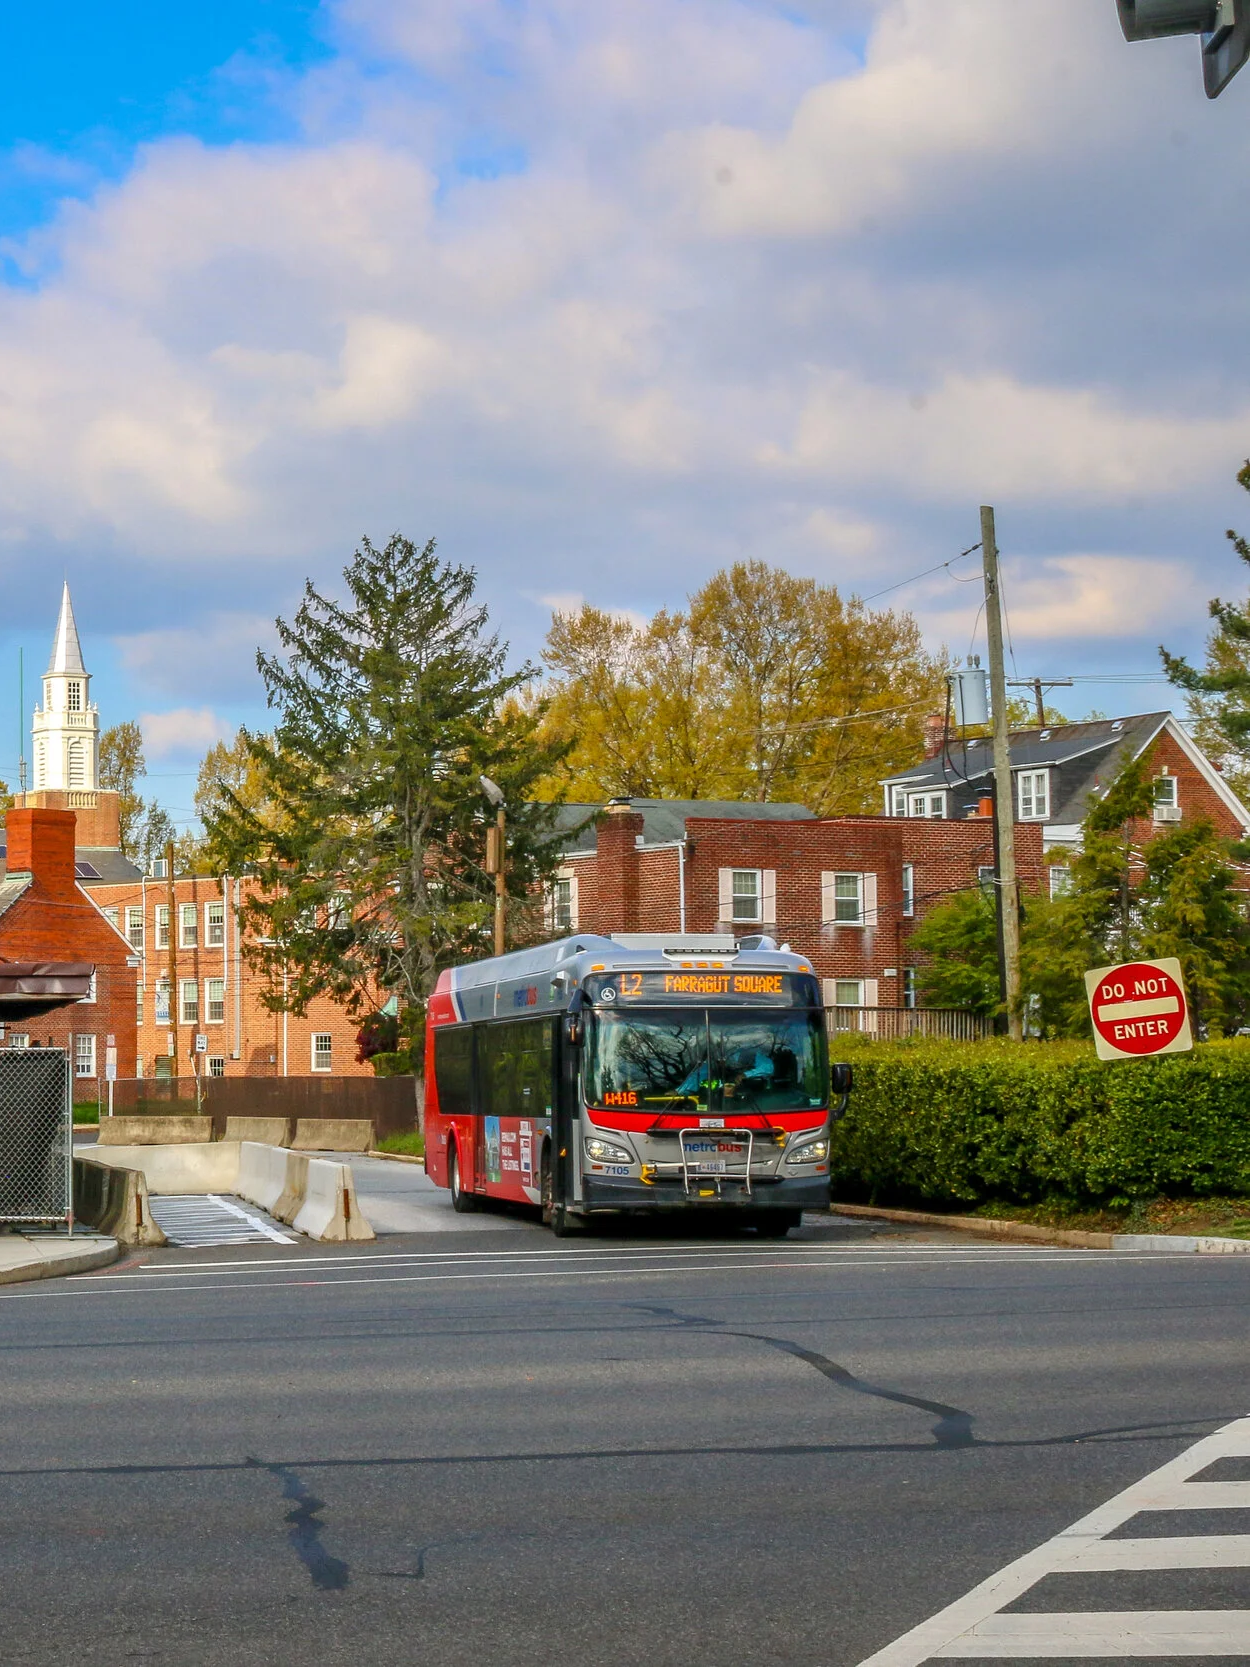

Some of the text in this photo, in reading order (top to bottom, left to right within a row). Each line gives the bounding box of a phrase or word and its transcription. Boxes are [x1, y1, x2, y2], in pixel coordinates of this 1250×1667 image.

[619, 972, 783, 996] L2 FARRAGUT SQUARE
[1101, 977, 1168, 1000] DO NOT
[1113, 1019, 1169, 1040] ENTER
[605, 1091, 637, 1105] W416
[605, 1166, 630, 1176] 7105
